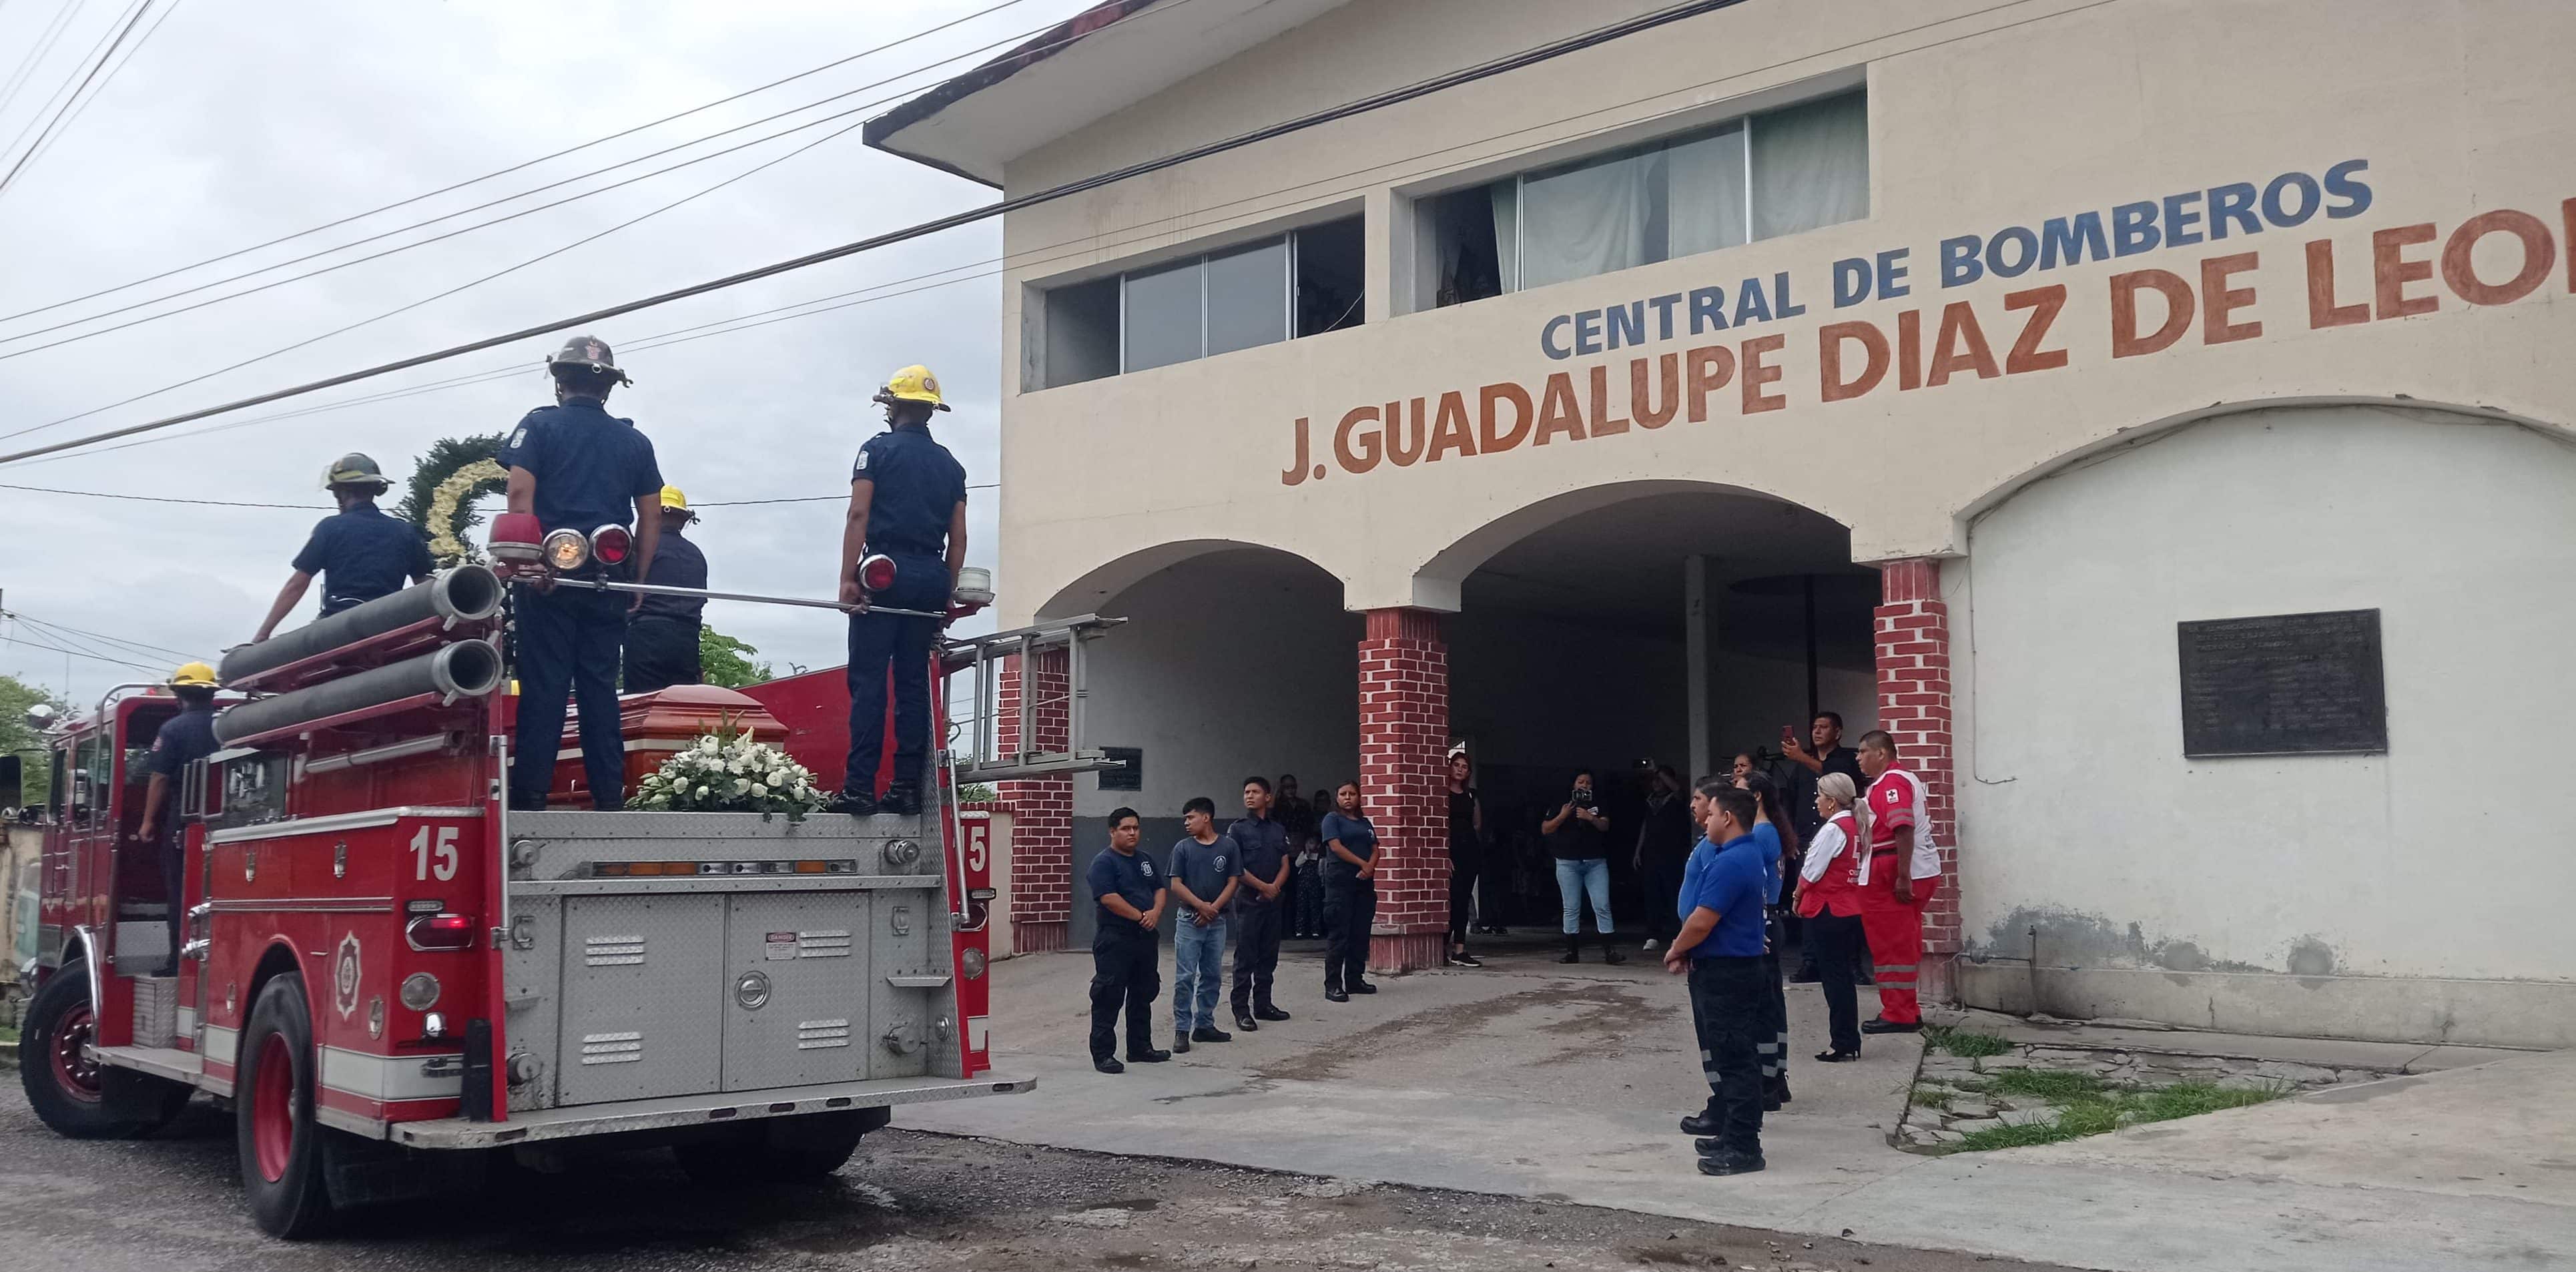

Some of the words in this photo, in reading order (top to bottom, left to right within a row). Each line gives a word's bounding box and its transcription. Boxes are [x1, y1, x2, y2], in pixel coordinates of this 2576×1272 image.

[1541, 272, 1806, 360] CENTRAL
[1833, 247, 1911, 308] DE
[1940, 160, 2373, 288] BOMBEROS
[1819, 284, 2068, 402] DIAZ
[2110, 251, 2263, 357] DE
[410, 825, 459, 881] 15
